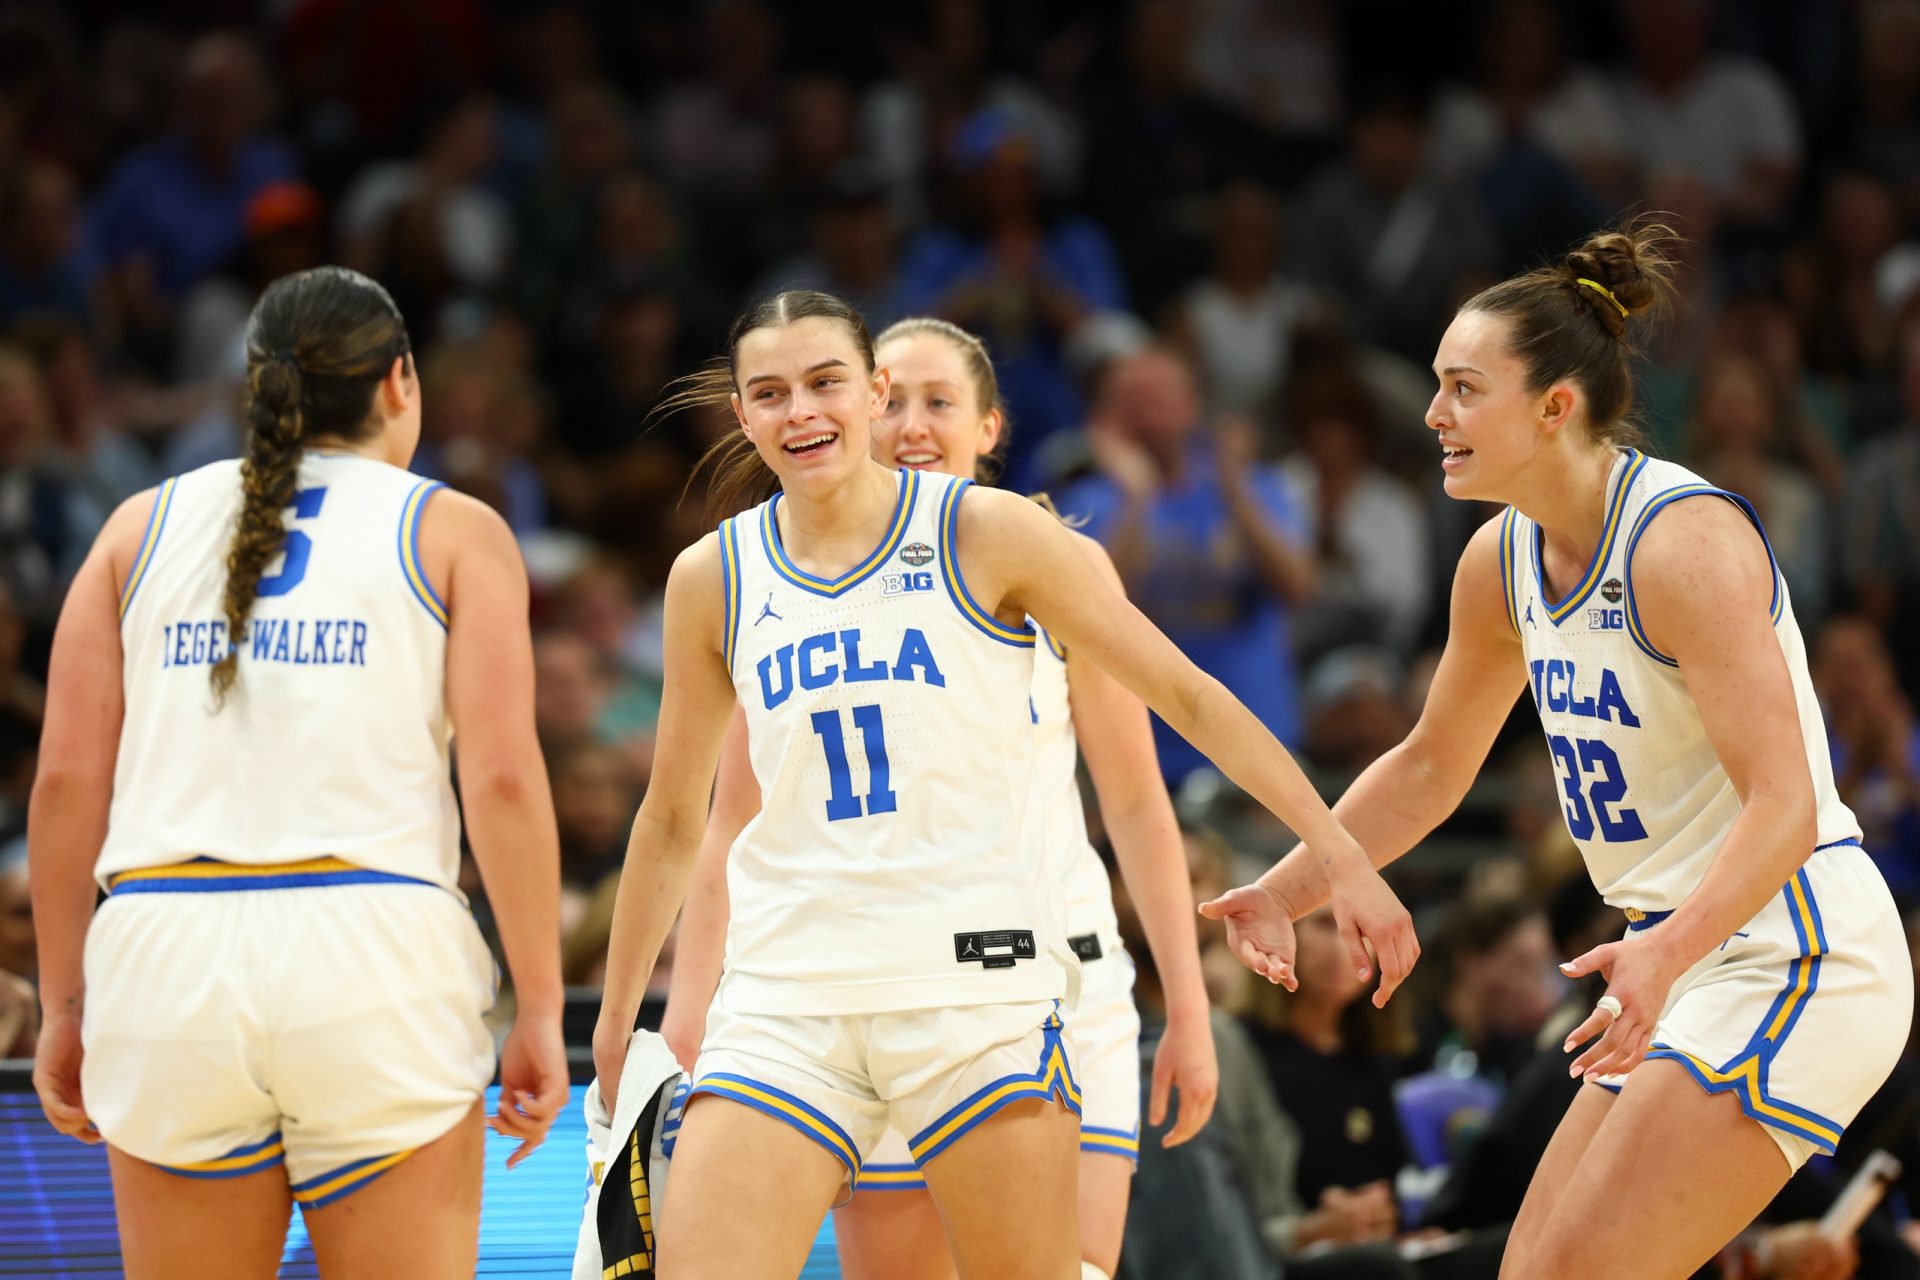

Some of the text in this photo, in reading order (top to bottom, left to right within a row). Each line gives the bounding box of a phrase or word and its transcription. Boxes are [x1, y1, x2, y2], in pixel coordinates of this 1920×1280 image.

[163, 618, 367, 668] EGE-WALKER
[757, 628, 946, 711] UCLA
[811, 704, 897, 822] 11
[1547, 733, 1648, 842] 32
[1018, 938, 1030, 949] 44
